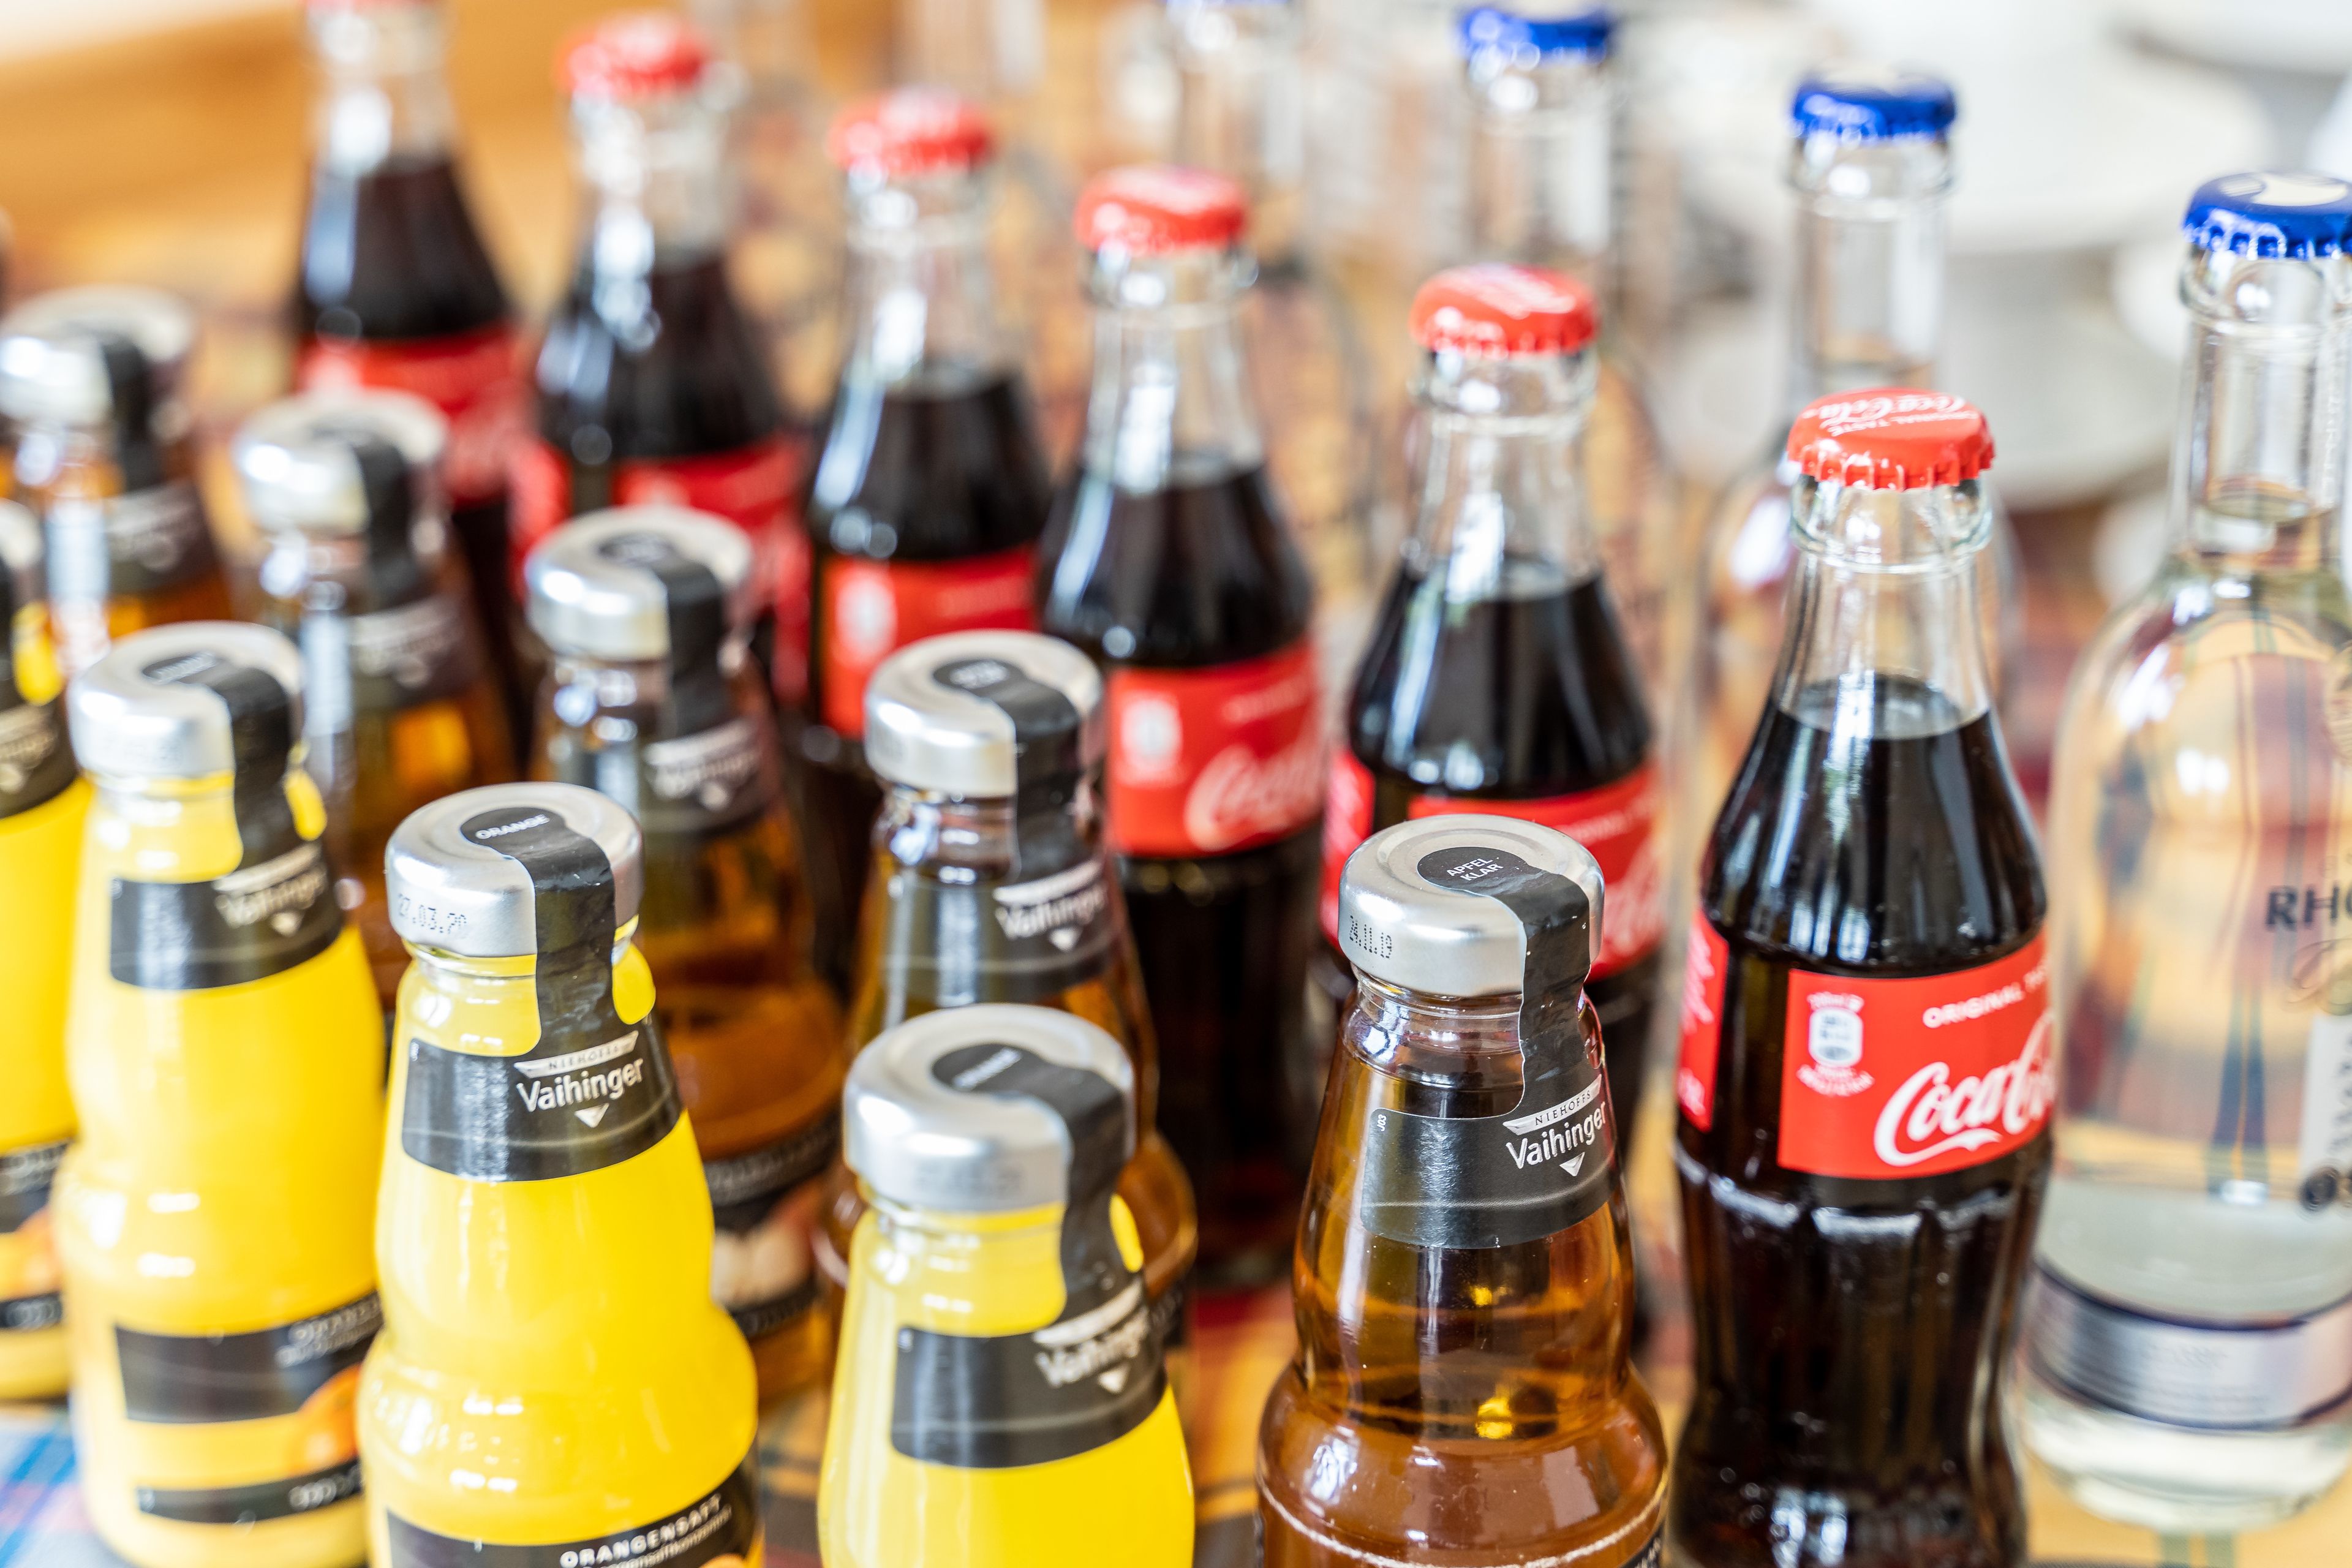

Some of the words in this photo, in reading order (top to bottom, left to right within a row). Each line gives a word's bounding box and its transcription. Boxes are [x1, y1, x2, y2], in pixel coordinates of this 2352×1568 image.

[475, 813, 550, 840] ORANGE
[1446, 858, 1493, 876] APFEL
[1460, 864, 1504, 881] KLAR
[2264, 884, 2352, 931] RH
[1922, 981, 2025, 1029] ORIGINAL
[516, 1058, 644, 1112] Vaihinger
[1535, 1090, 1591, 1126] NIEHOFFS
[1506, 1101, 1606, 1169] Vaihinger
[559, 1492, 722, 1568] ORANGENSAFT
